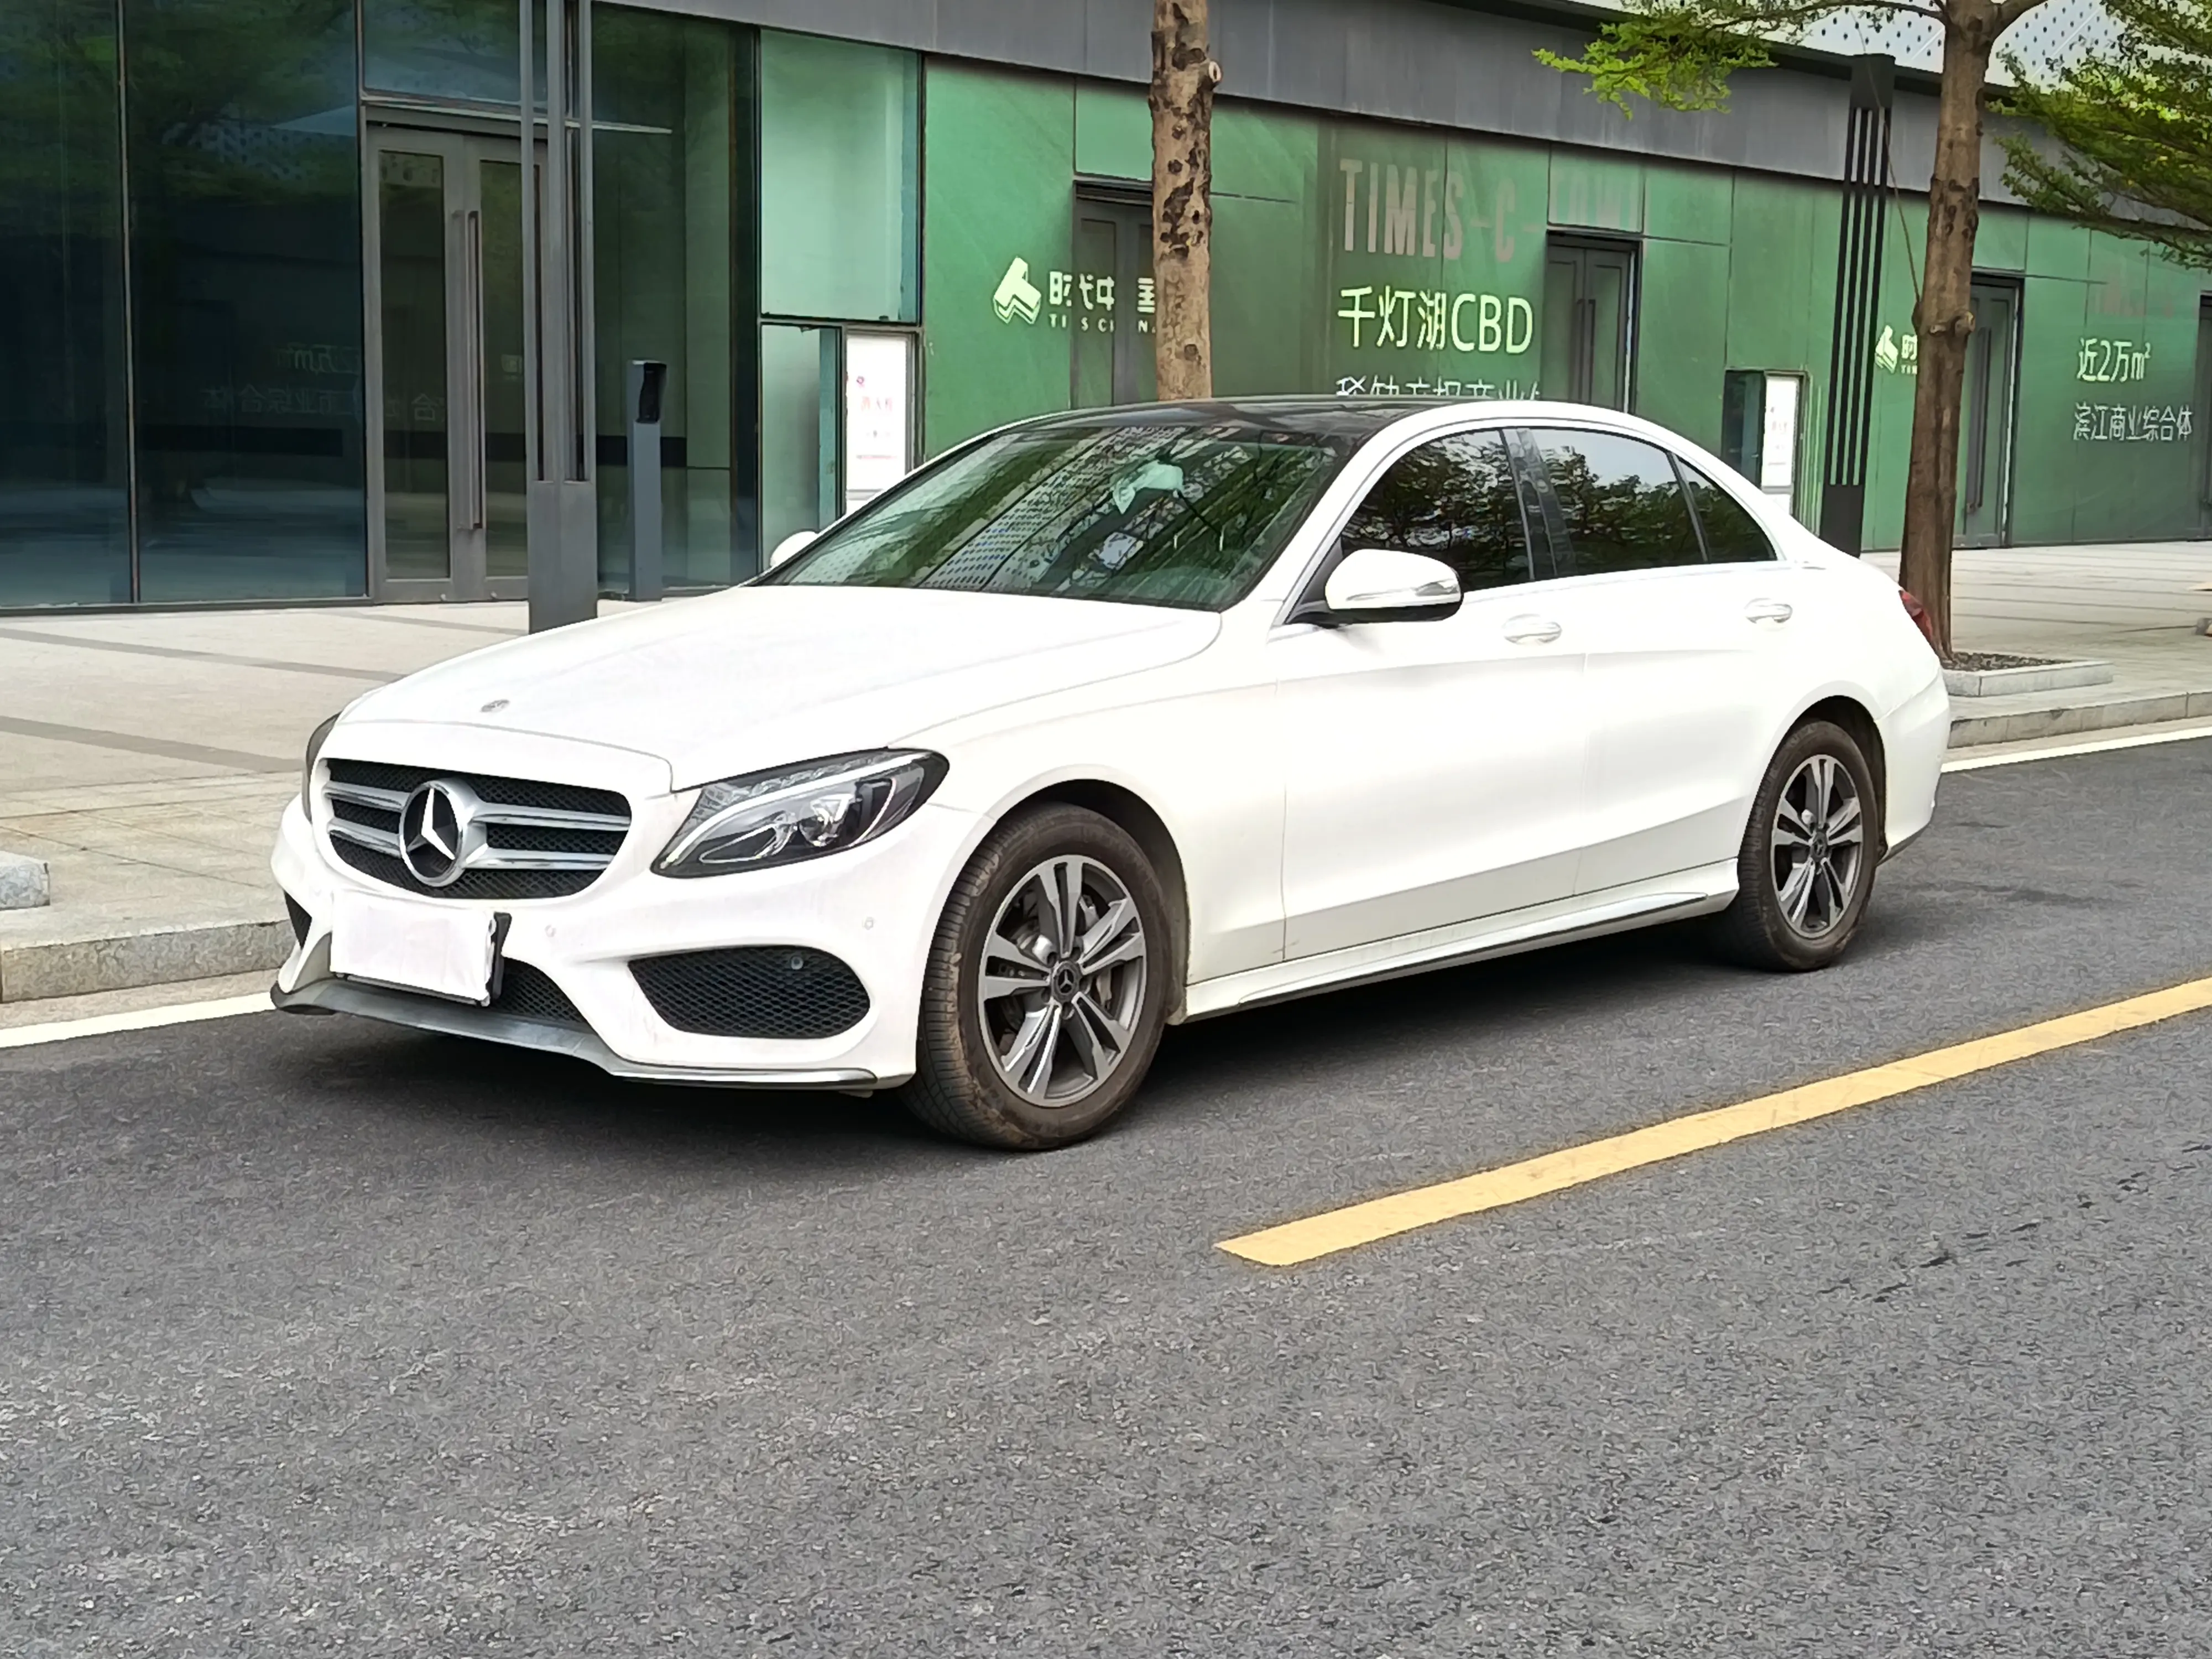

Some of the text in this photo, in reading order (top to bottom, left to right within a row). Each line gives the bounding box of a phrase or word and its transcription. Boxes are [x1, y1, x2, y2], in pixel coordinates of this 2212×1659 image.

[1337, 284, 1533, 354] 千灯湖CBD
[2072, 401, 2194, 442] 滨江商业综合体
